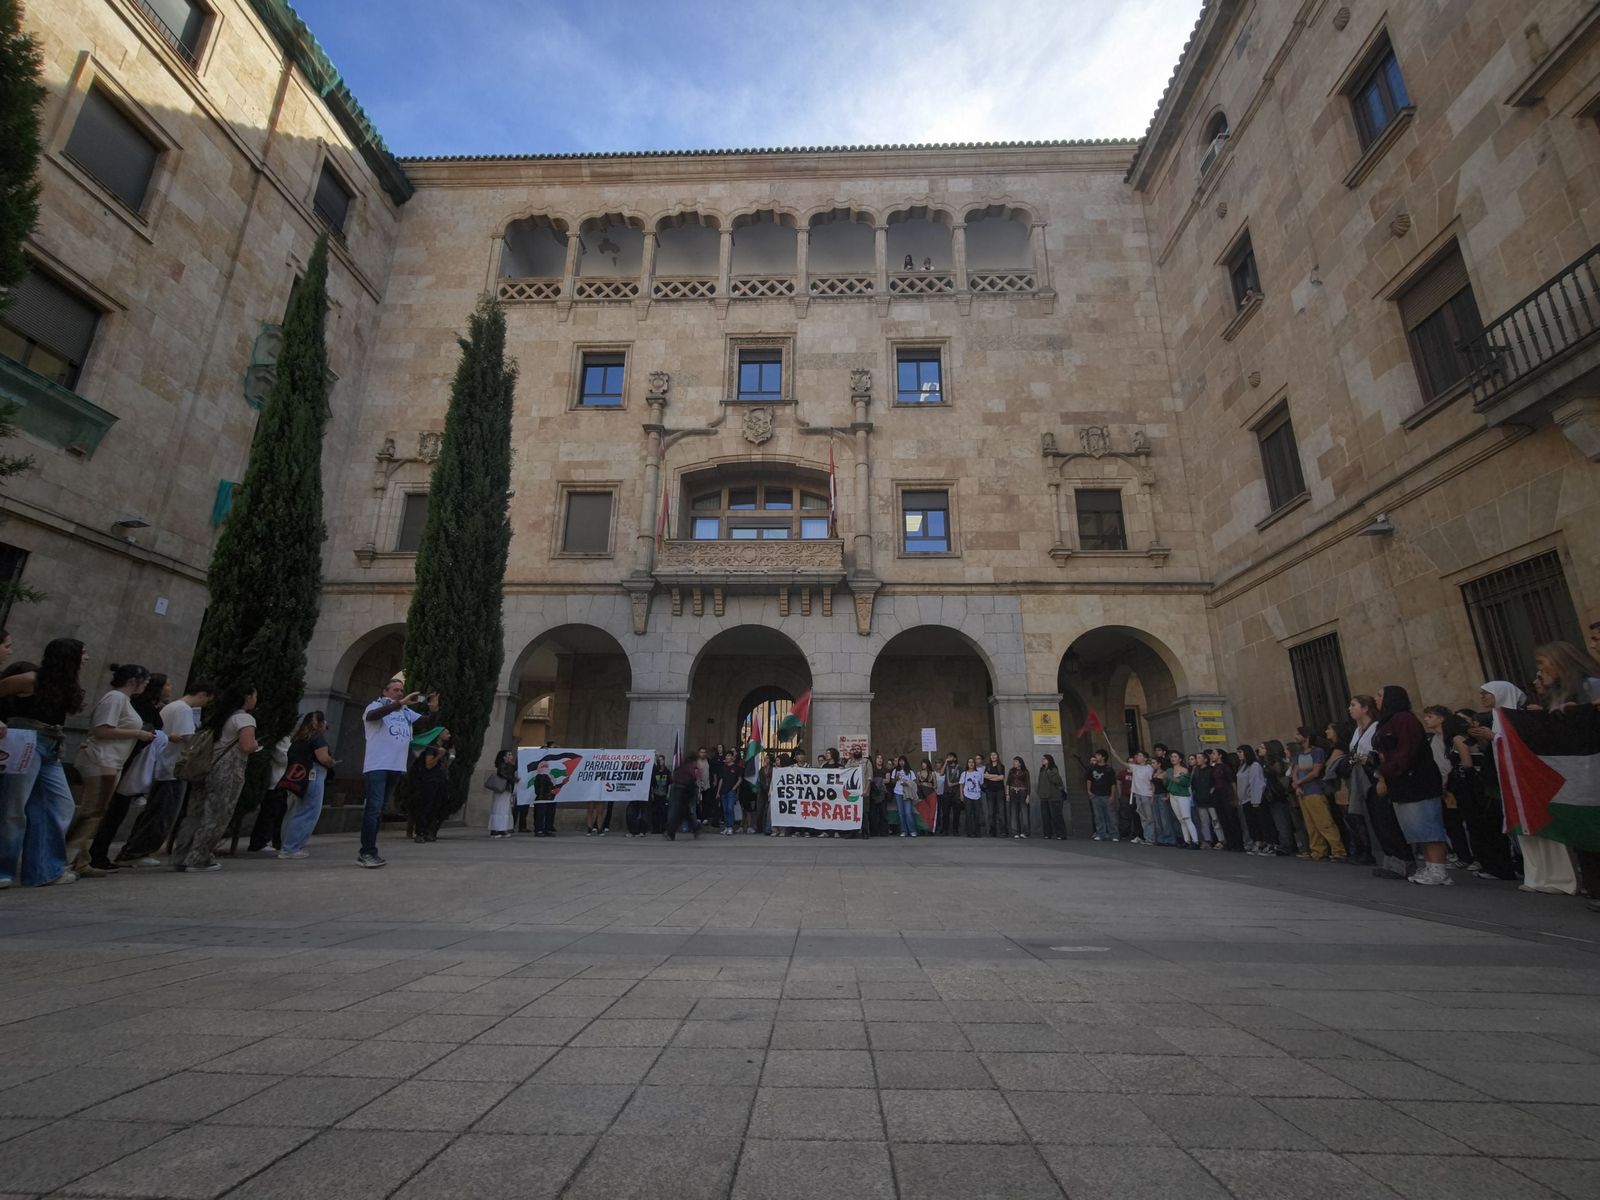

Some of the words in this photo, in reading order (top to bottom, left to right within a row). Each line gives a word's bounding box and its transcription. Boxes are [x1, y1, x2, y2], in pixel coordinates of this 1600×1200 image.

[584, 760, 619, 771] PARARLO
[620, 760, 646, 771] TODO
[577, 771, 594, 781] POR
[594, 771, 644, 781] PALESTINA
[777, 773, 820, 785] ABAJO
[826, 773, 843, 785] EL
[777, 786, 837, 801] ESTADO
[778, 799, 797, 814] DE
[800, 800, 861, 822] ISRAEL
